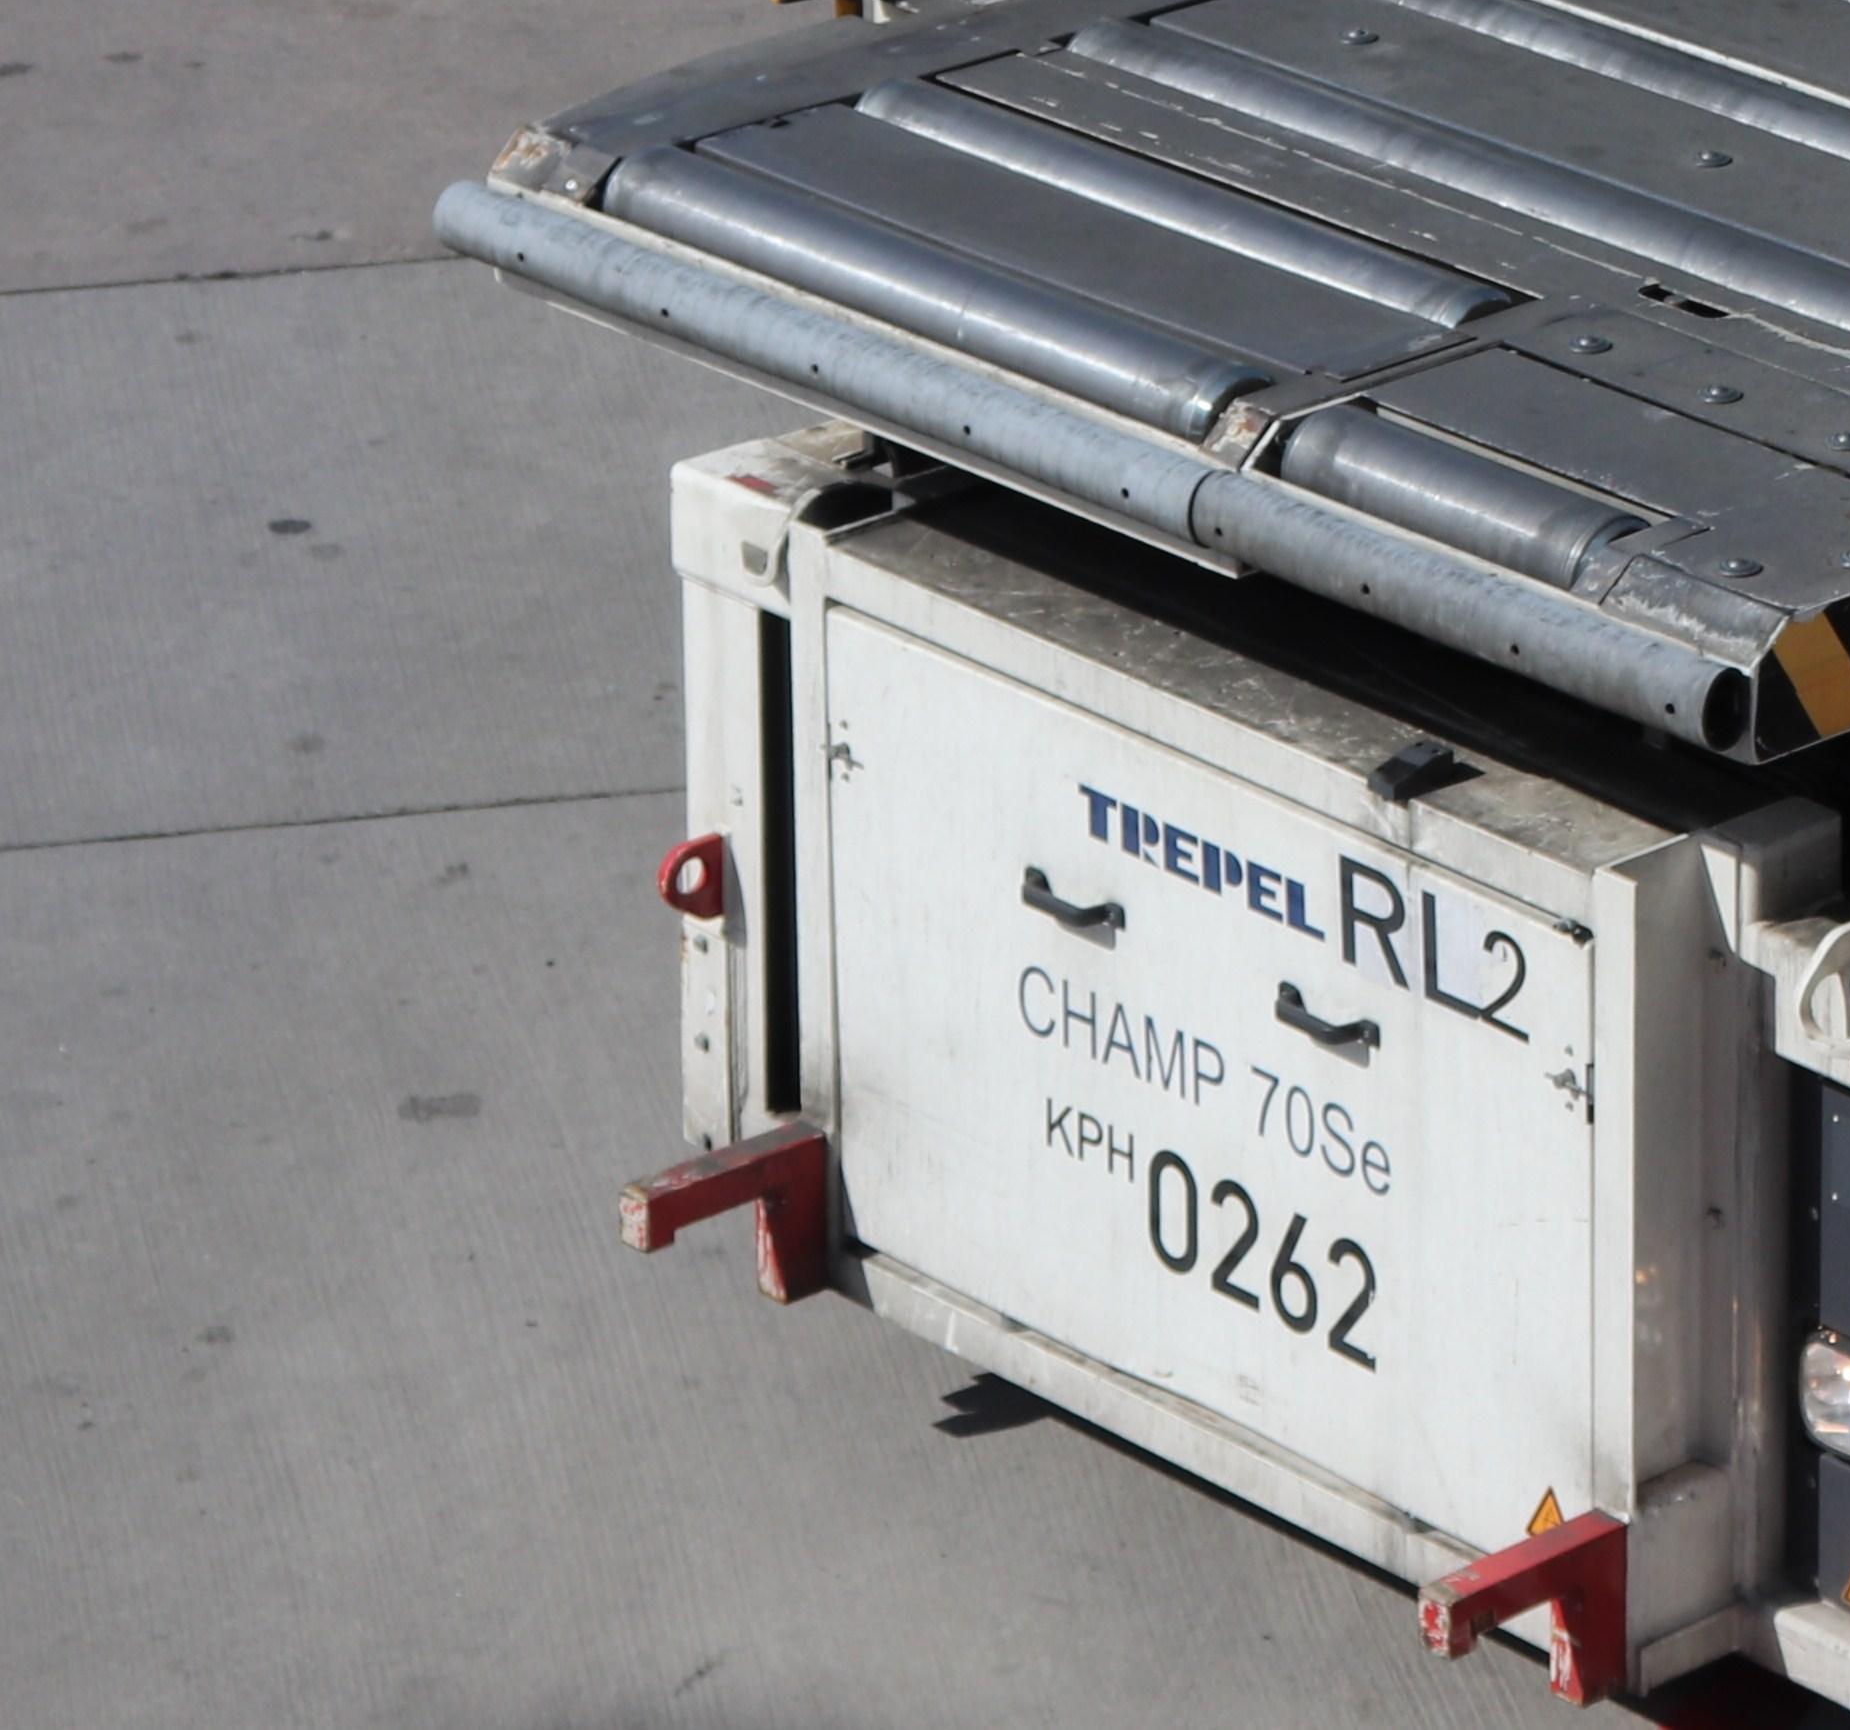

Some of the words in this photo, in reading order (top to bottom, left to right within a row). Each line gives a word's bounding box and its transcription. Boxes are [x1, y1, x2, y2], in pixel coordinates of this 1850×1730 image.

[1078, 783, 1326, 942] TREPEL
[1339, 854, 1530, 1044] RL2
[1018, 965, 1225, 1106] CHAMP
[1250, 1065, 1391, 1196] 70Se
[1046, 1097, 1134, 1183] KPH
[1148, 1148, 1377, 1372] 0262
